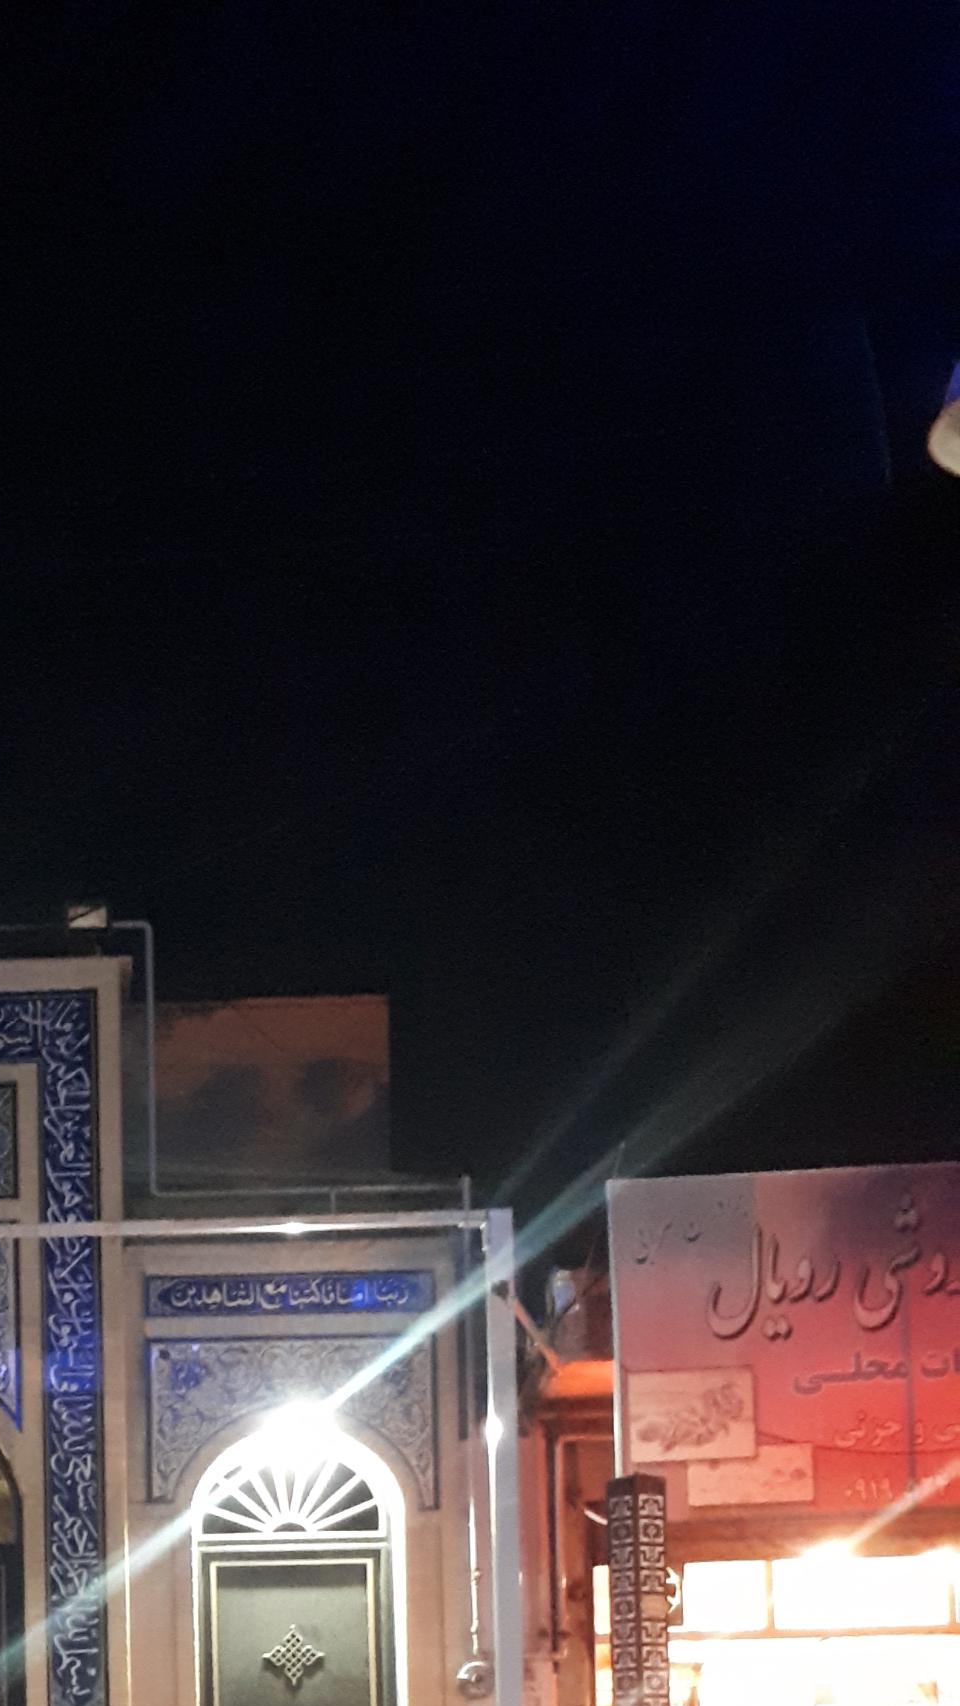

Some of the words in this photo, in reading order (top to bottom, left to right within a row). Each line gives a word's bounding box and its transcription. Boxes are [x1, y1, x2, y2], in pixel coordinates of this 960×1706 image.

[707, 1222, 840, 1341] رویال
[852, 1192, 959, 1332] وشی
[793, 1350, 909, 1394] محلی
